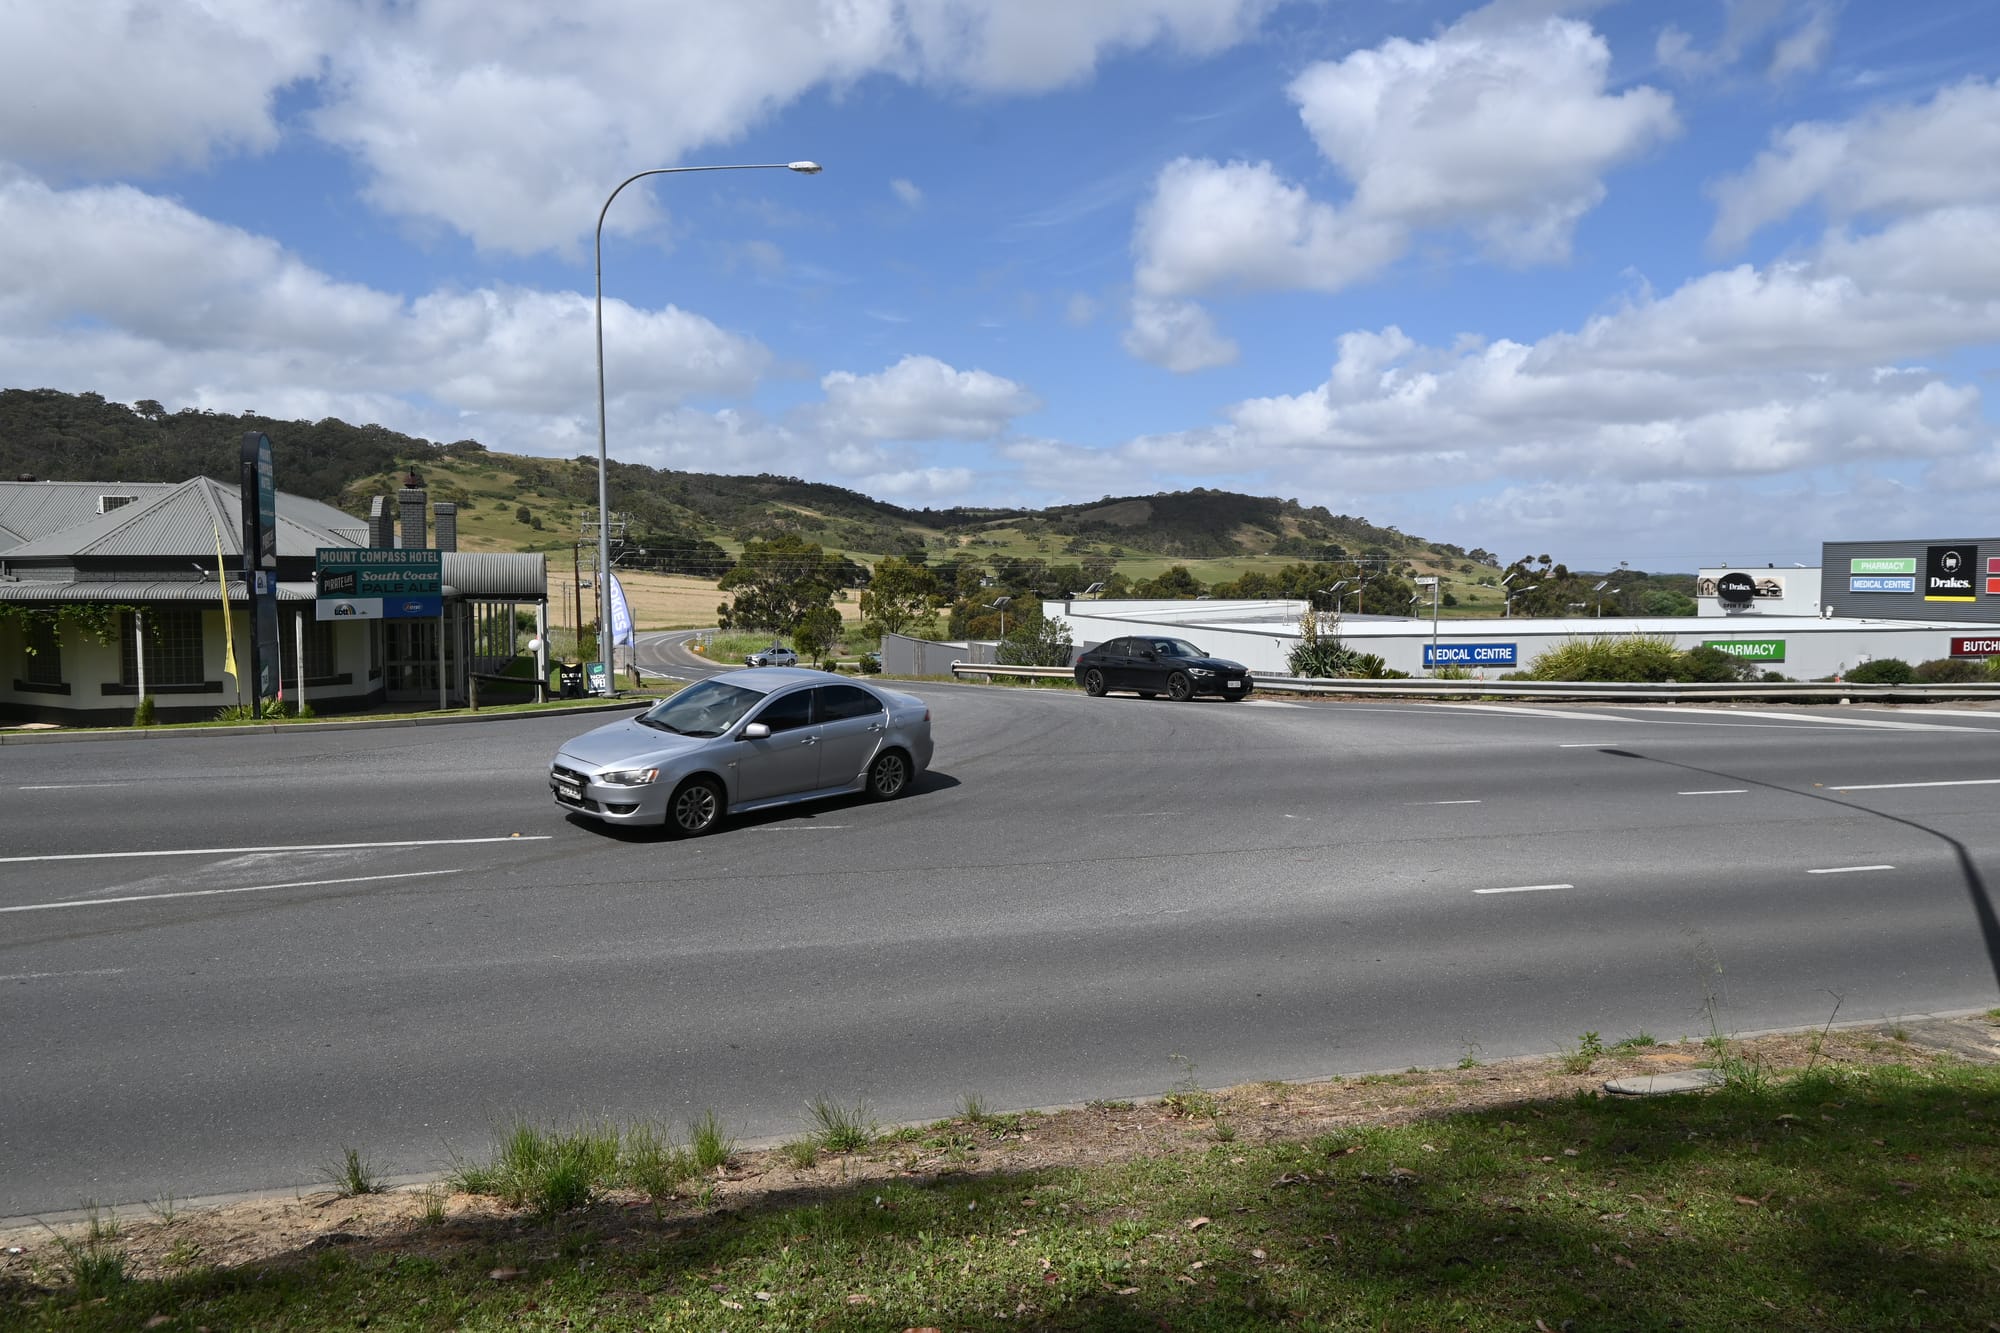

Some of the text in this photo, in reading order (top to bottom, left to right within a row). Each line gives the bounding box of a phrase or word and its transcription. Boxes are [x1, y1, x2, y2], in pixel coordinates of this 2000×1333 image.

[320, 551, 439, 562] MOUNT COMPASS HOTEL
[1861, 561, 1905, 570] PHARMACY
[362, 570, 439, 581] South Coast
[362, 582, 439, 593] PALE ALE
[1853, 580, 1911, 589] MEDICAL CENTRE
[611, 580, 627, 632] OKIES
[1474, 648, 1512, 659] CENTRE
